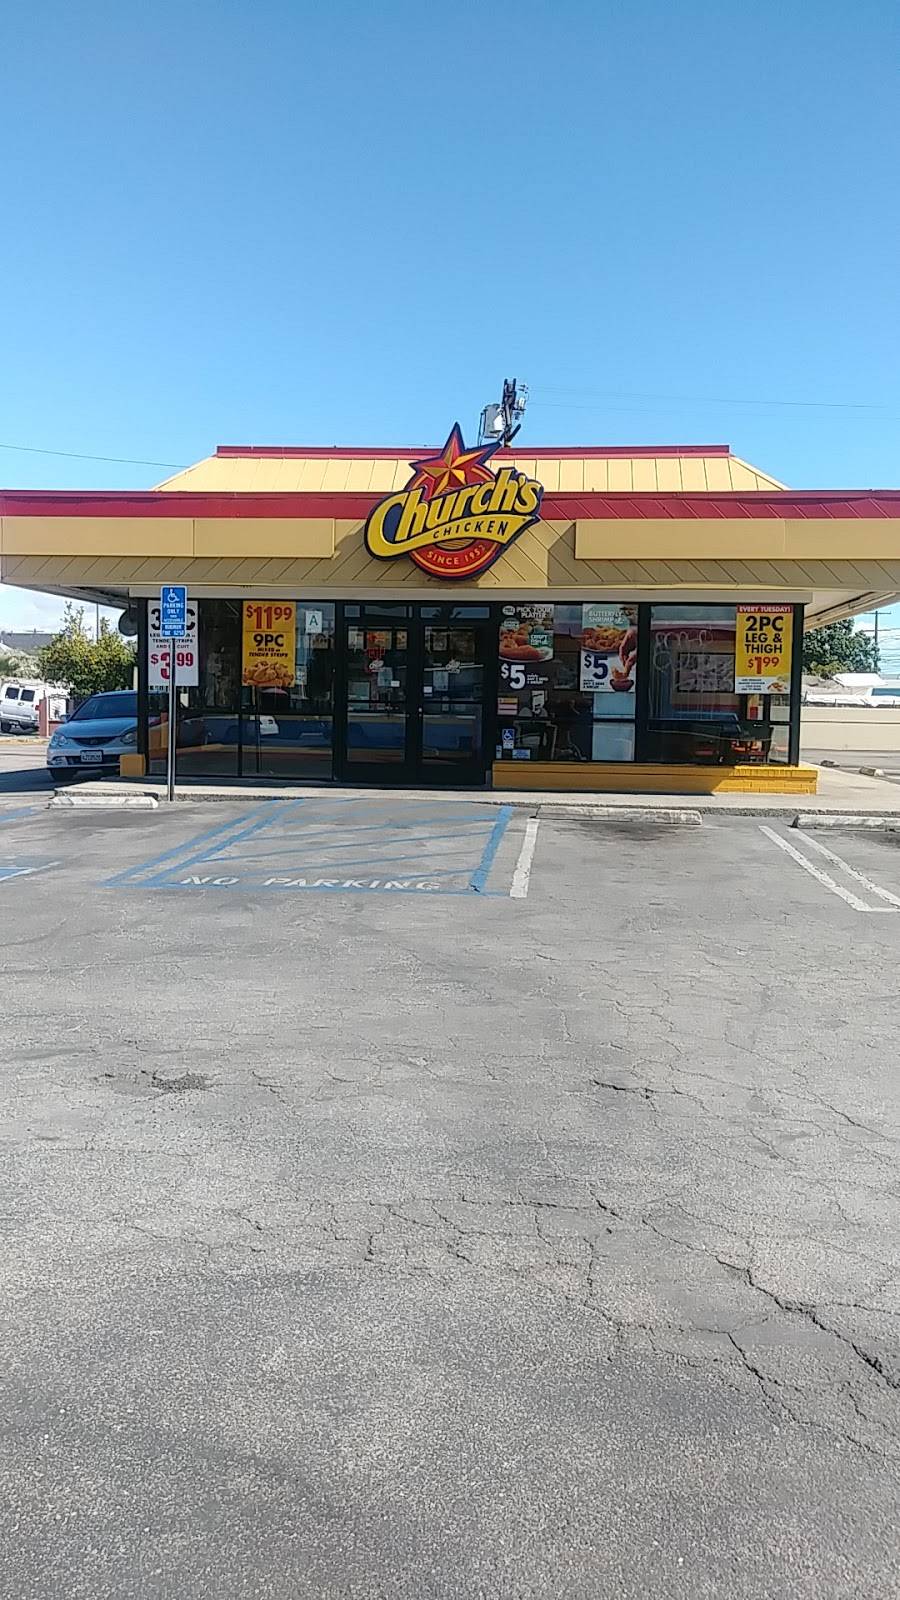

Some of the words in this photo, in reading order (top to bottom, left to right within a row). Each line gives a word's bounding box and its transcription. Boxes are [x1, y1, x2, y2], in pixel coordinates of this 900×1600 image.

[366, 469, 541, 554] Church's
[432, 519, 510, 540] CHICKEN
[426, 550, 460, 566] SINCE
[464, 544, 487, 563] 1952
[308, 614, 319, 627] A
[745, 615, 784, 632] 2PC
[253, 633, 284, 648] 9PC
[745, 633, 768, 643] LEG
[773, 633, 783, 643] &
[745, 644, 783, 654] THIGH
[583, 653, 609, 680] $5
[500, 662, 526, 690] $5
[180, 875, 240, 886] NO
[263, 876, 442, 890] PARKING
